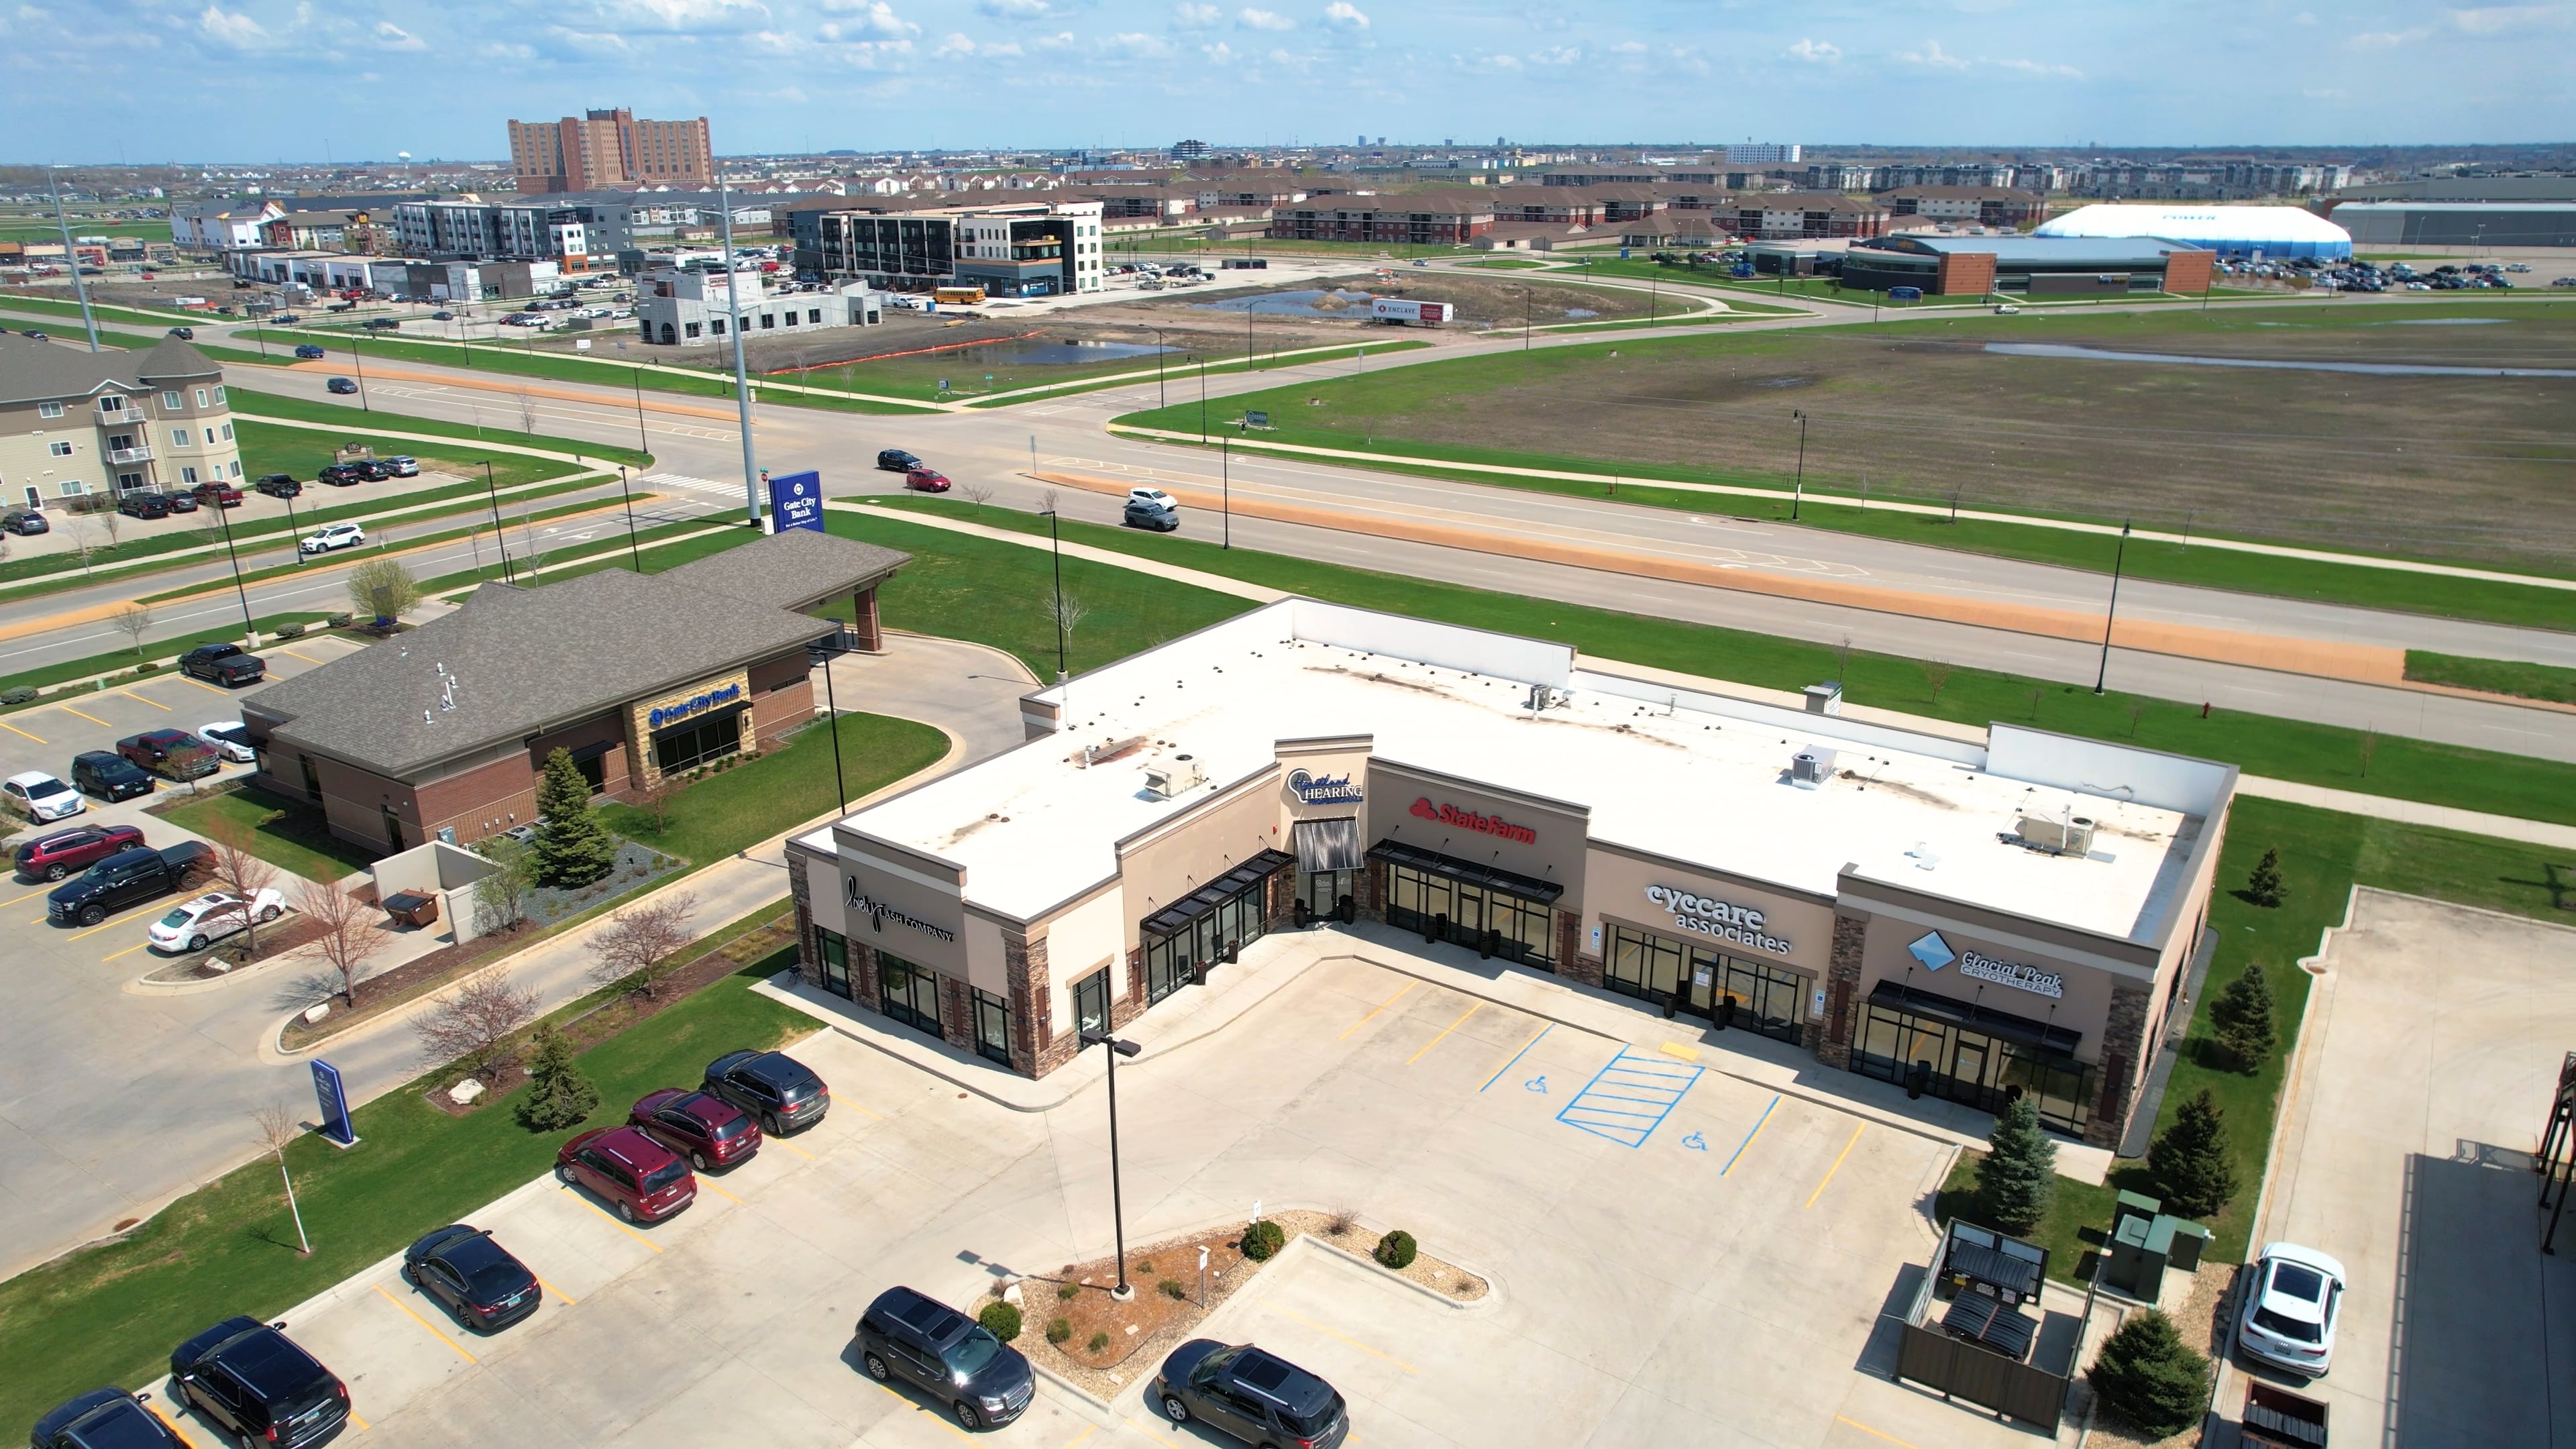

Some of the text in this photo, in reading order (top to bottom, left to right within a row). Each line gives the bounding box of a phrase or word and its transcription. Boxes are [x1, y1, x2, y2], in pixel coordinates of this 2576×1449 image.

[1388, 305, 1415, 314] ENCLAVE
[784, 496, 816, 511] Gate City
[791, 507, 811, 519] Bank
[665, 683, 741, 718] Gate City Bank
[1305, 786, 1363, 800] HEARING
[1646, 884, 1766, 930] eyecare
[879, 907, 905, 924] LASH
[905, 917, 954, 943] COMPANY
[1675, 913, 1791, 956] associates
[1962, 951, 2063, 989] Glacial Peak
[1962, 966, 2061, 998] CRYOTHERAPY
